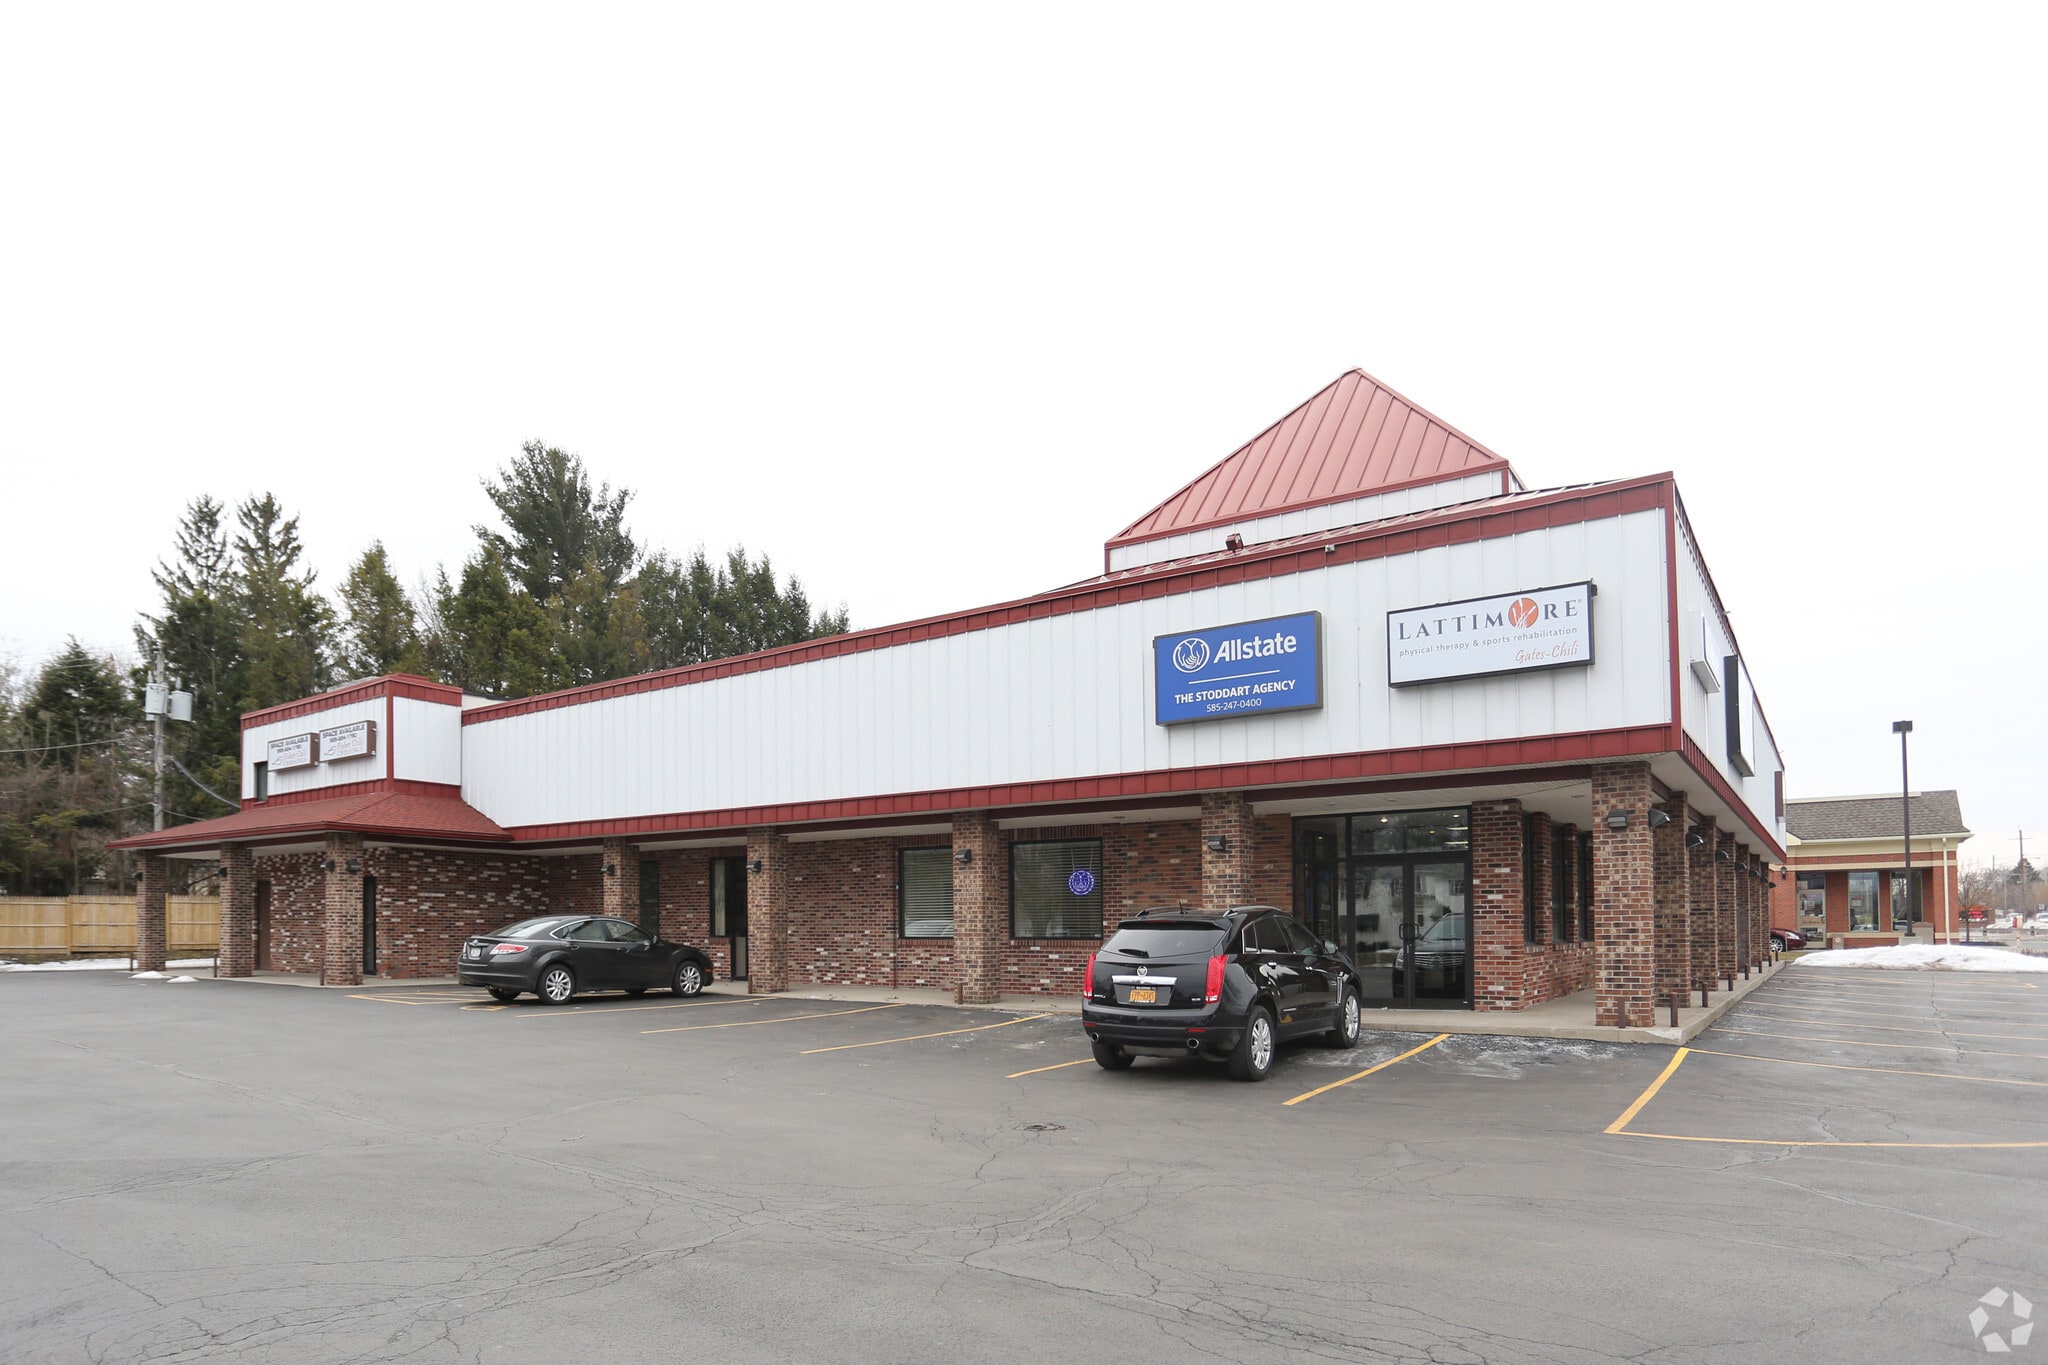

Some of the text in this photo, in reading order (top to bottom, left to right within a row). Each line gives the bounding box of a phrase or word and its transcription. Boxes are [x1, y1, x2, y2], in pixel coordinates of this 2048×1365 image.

[1213, 632, 1297, 664] Allstate
[1399, 627, 1578, 658] physical therapy & sports rehabilitation
[1515, 640, 1579, 664] Gates-Chili
[1174, 679, 1296, 704] THE STODDART AGENCY
[1206, 698, 1262, 712] 585-247-0400
[270, 741, 284, 750] SPACE
[285, 736, 309, 747] AVAILABLE
[322, 724, 365, 739] SPACE AVAILABLE
